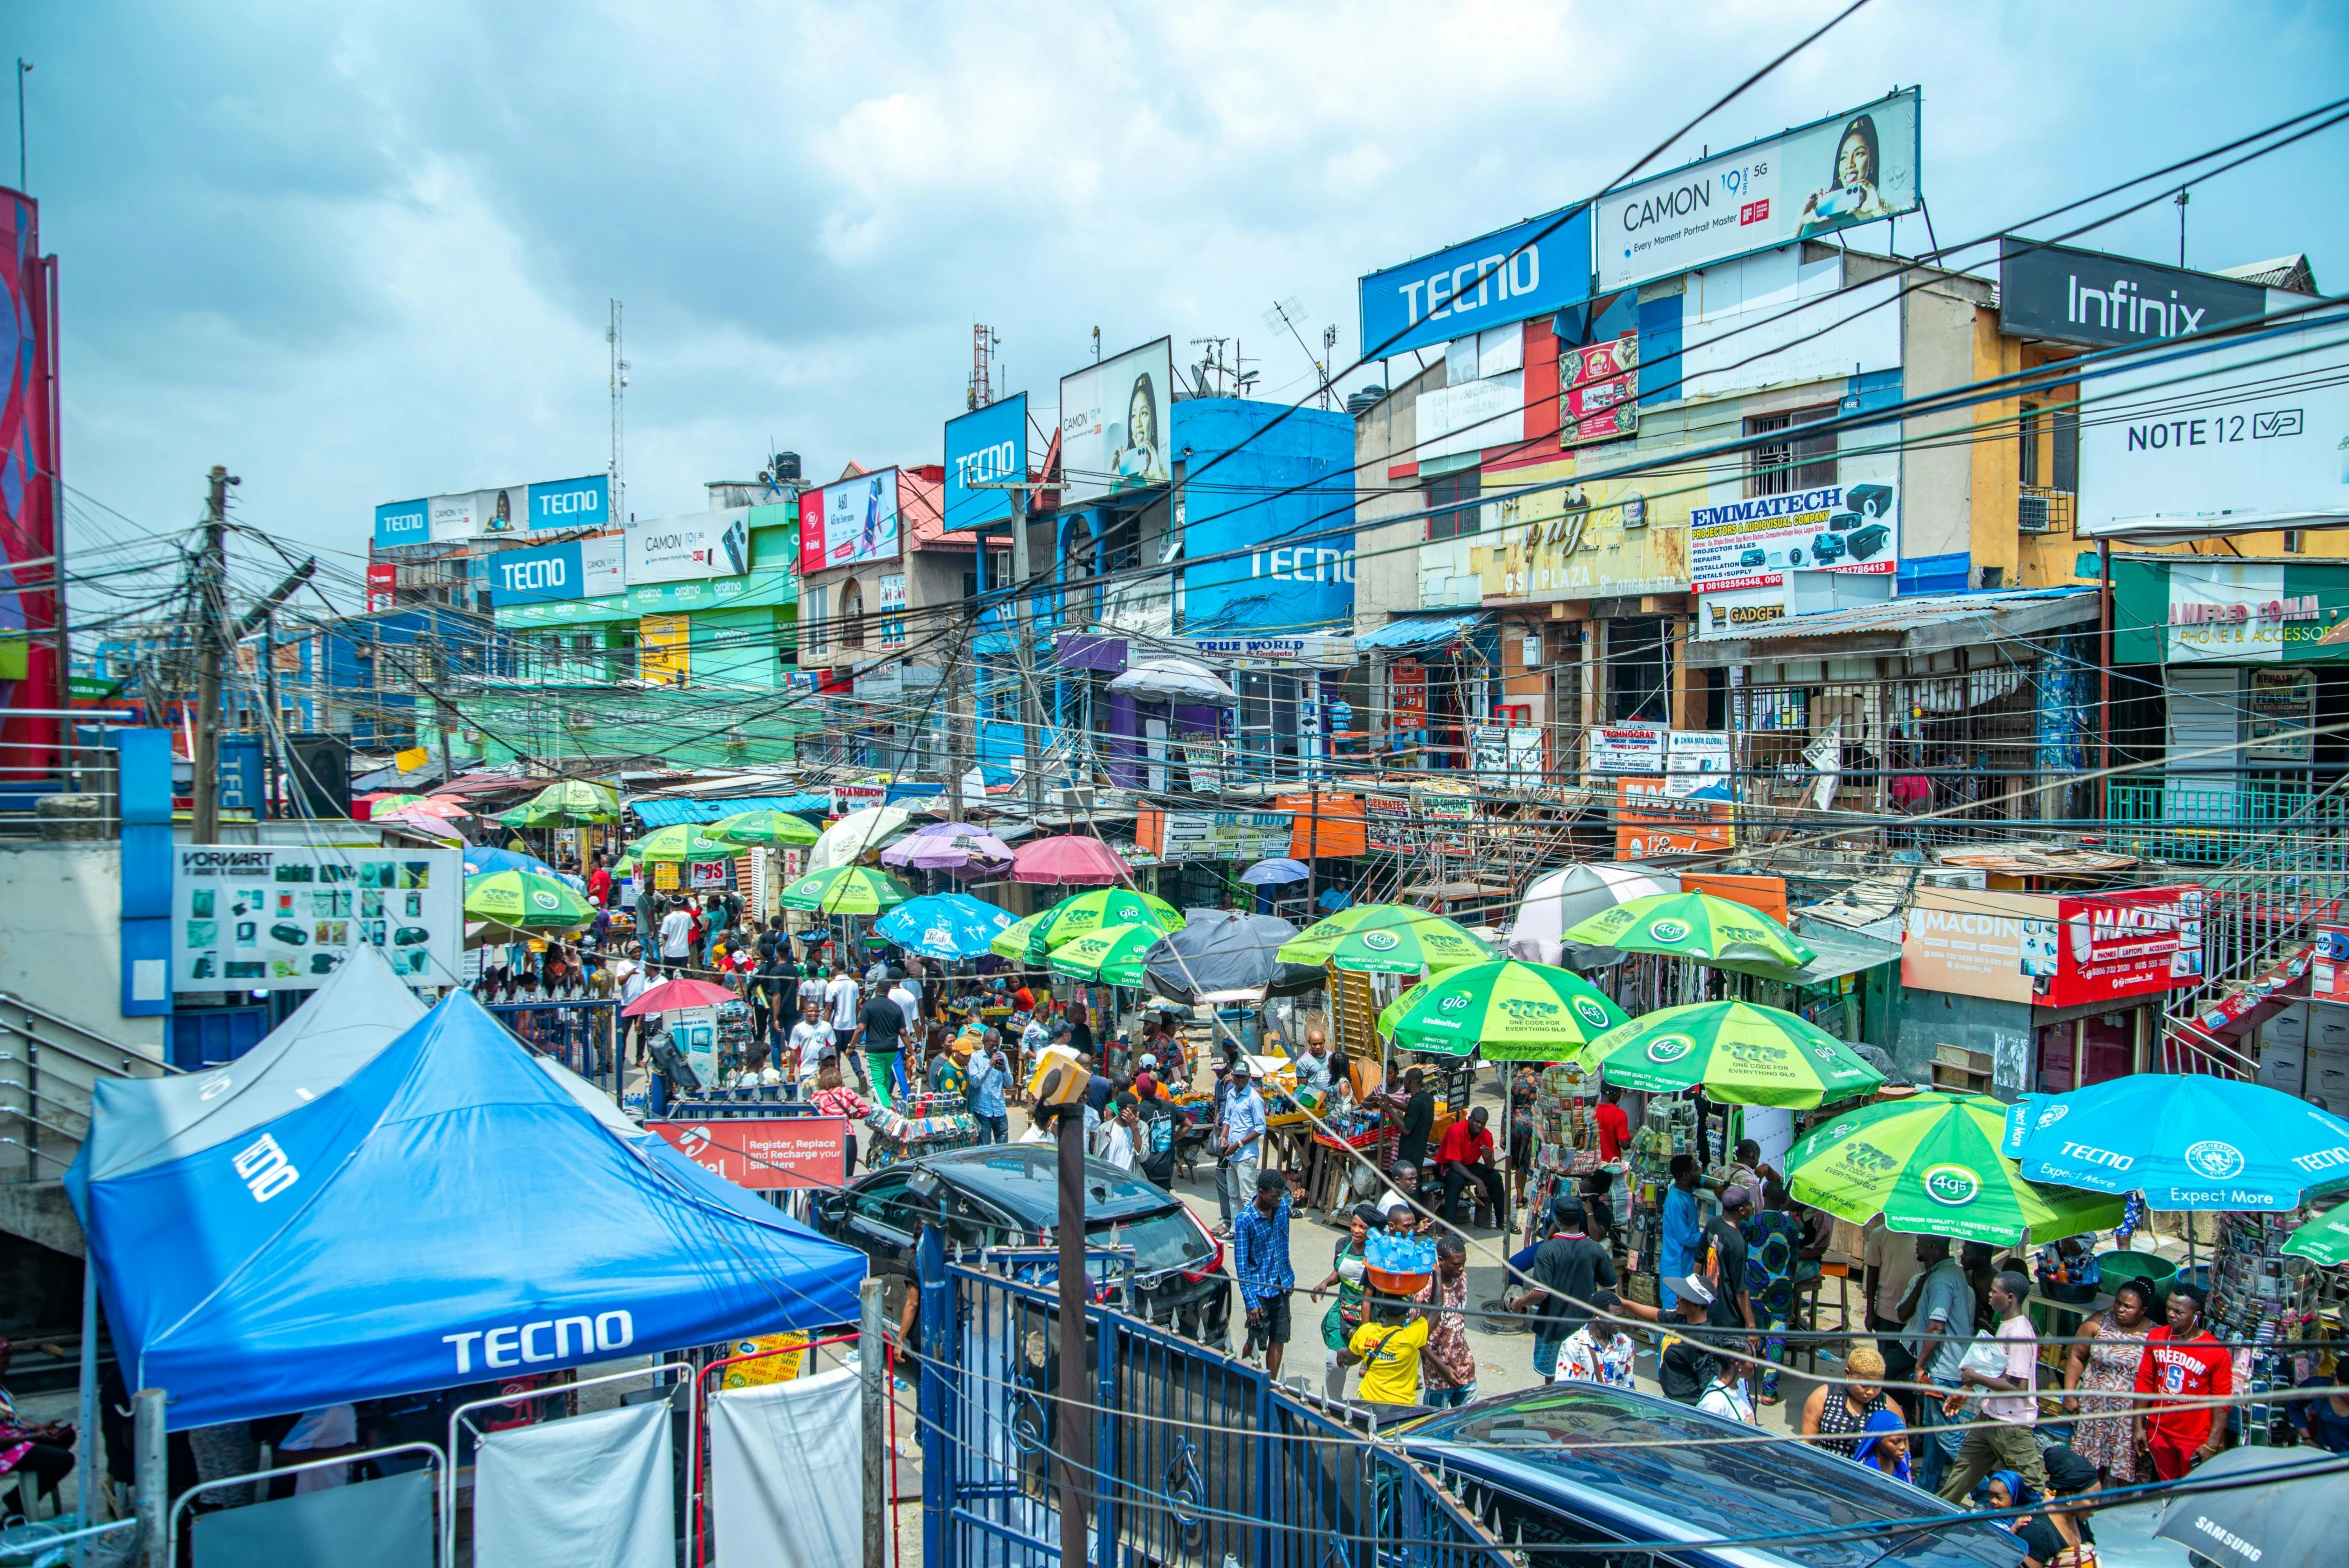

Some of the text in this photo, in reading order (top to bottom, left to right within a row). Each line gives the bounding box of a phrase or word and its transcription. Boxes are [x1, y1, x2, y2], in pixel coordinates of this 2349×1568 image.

[1754, 163, 1768, 177] 5G
[1624, 170, 1740, 232] CAMON 19
[1634, 213, 1737, 253] Every Moment Portrait Master
[1399, 243, 1539, 328] TECNO
[2069, 275, 2205, 337] Infinix
[1063, 412, 1087, 431] CAMON
[2128, 416, 2245, 451] NOTE 12
[956, 440, 1014, 488] TECNO
[539, 490, 597, 515] TECNO
[838, 494, 847, 510] A60
[1691, 488, 1842, 527] EMMATECH
[435, 509, 456, 518] CAMON
[384, 514, 423, 532] TECNO
[1692, 510, 1830, 540] PROJECTORS & AUDIOVISUAL COMPANY
[646, 534, 682, 551] CAMON
[1693, 542, 1756, 555] PROJECTOR SALES
[587, 560, 605, 569] CAMON
[1693, 555, 1721, 563] REPAIRS
[1693, 562, 1739, 571] INSTALLATION
[501, 558, 565, 590] TECNO
[1542, 566, 1675, 594] PLAZA OTIGBA STR
[1693, 572, 1722, 580] RENTALS
[675, 585, 700, 596] oraimo
[714, 582, 741, 592] oraimo
[1706, 578, 1763, 590] 08182554348,
[638, 588, 662, 598] oraimo
[2180, 630, 2244, 643] PHONE &
[1196, 641, 1304, 650] TRUE WORLD
[2257, 674, 2292, 683] REPAIR
[2256, 695, 2290, 703] FLASH
[1602, 730, 1655, 738] TECHNOCRAT
[183, 852, 274, 866] VORWART
[1120, 910, 1139, 920] glo
[2093, 903, 2179, 941] MACDIN
[1926, 909, 2019, 939] MACDIN
[926, 930, 947, 943] Peak
[2098, 943, 2177, 959] PHONES LAPTOPS ACCESSORIES
[1974, 956, 1988, 964] 0815
[1442, 995, 1466, 1009] glo
[1422, 1017, 1462, 1029] Unlimited
[1814, 1046, 1836, 1061] glo
[1728, 1067, 1776, 1078] EVERYTHING
[1732, 1061, 1747, 1069] ONE
[1749, 1062, 1771, 1070] CODE
[1453, 1074, 1462, 1085] NO
[1609, 1068, 1673, 1085] SUPERIOR QUALITY FASTEST
[1830, 1068, 1862, 1078] Unlimited
[750, 1139, 836, 1150] Register, Replace
[2012, 1128, 2023, 1147] More
[750, 1150, 841, 1159] and Recharge your
[2060, 1141, 2134, 1170] TECNO
[231, 1132, 300, 1203] TECNO
[750, 1161, 795, 1169] SIM Here
[1835, 1161, 1880, 1183] ONE CODE FOR
[1825, 1166, 1877, 1192] EVERYTHING GLO
[2040, 1163, 2116, 1188] Expect More
[2170, 1187, 2273, 1205] Expect More
[1891, 1215, 2014, 1235] SUPERIOR QUALITY FASTEST SPEED
[1932, 1224, 1972, 1236] BEST VALUE
[442, 1309, 634, 1375] TECNO
[781, 1358, 796, 1366] 500
[2153, 1349, 2207, 1375] FREEDOM
[777, 1366, 795, 1374] 200
[2165, 1364, 2185, 1394] S
[2194, 1516, 2262, 1562] SAMSUNG
